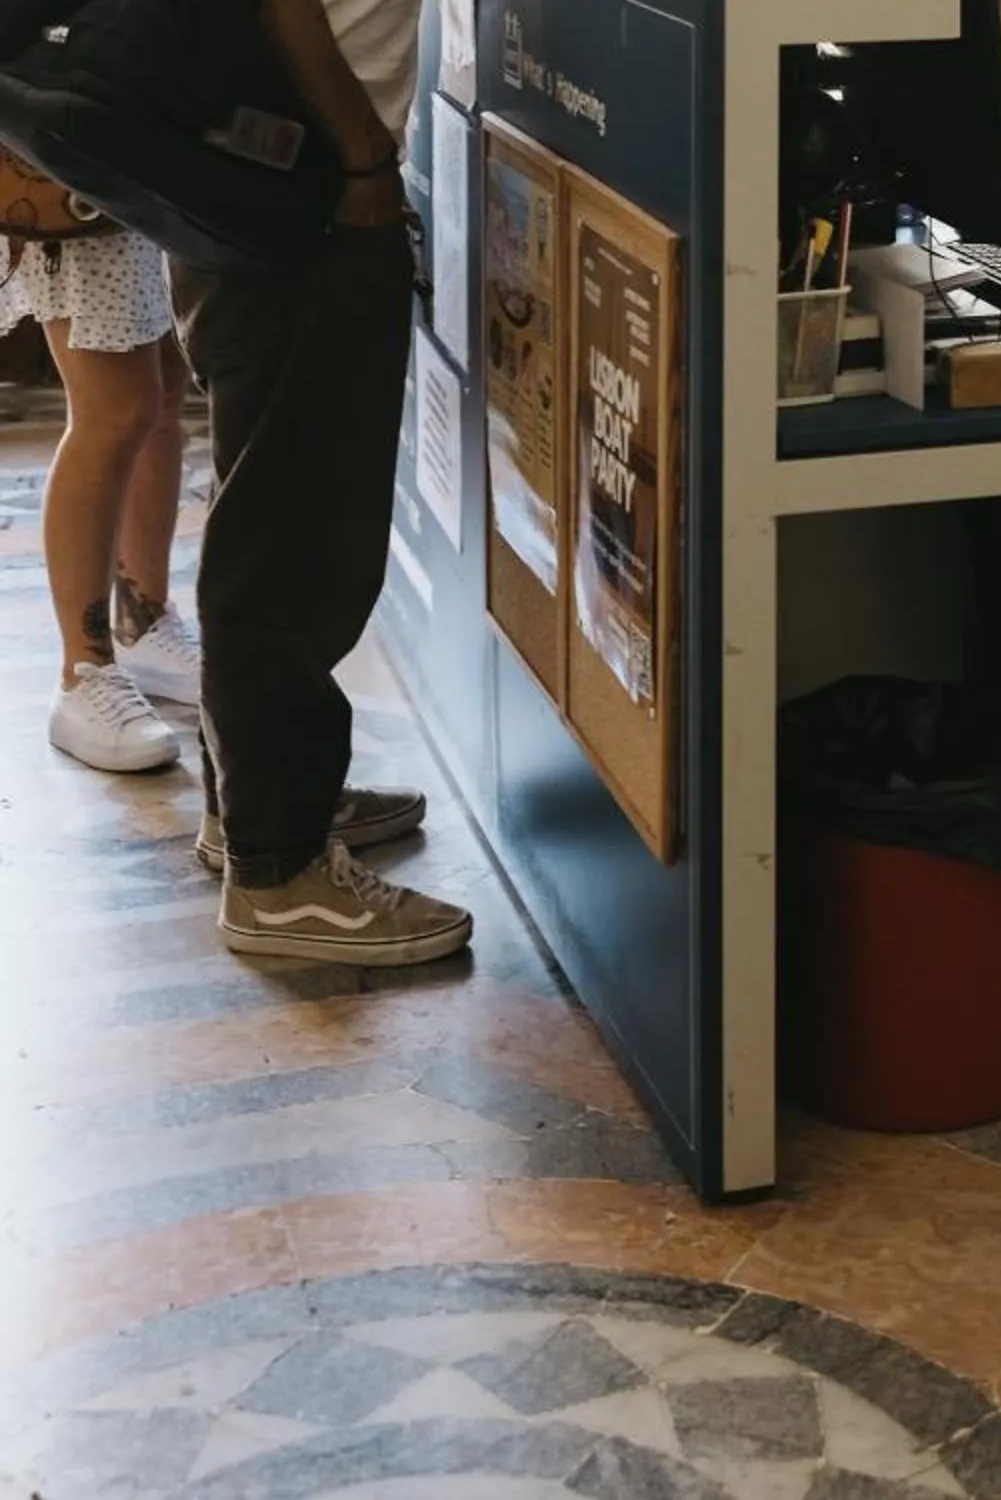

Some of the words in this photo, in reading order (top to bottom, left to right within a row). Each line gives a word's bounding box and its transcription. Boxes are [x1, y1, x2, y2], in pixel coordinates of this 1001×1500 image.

[589, 343, 640, 426] LISBON
[594, 396, 634, 463] BOAT
[591, 435, 637, 514] PARTY
